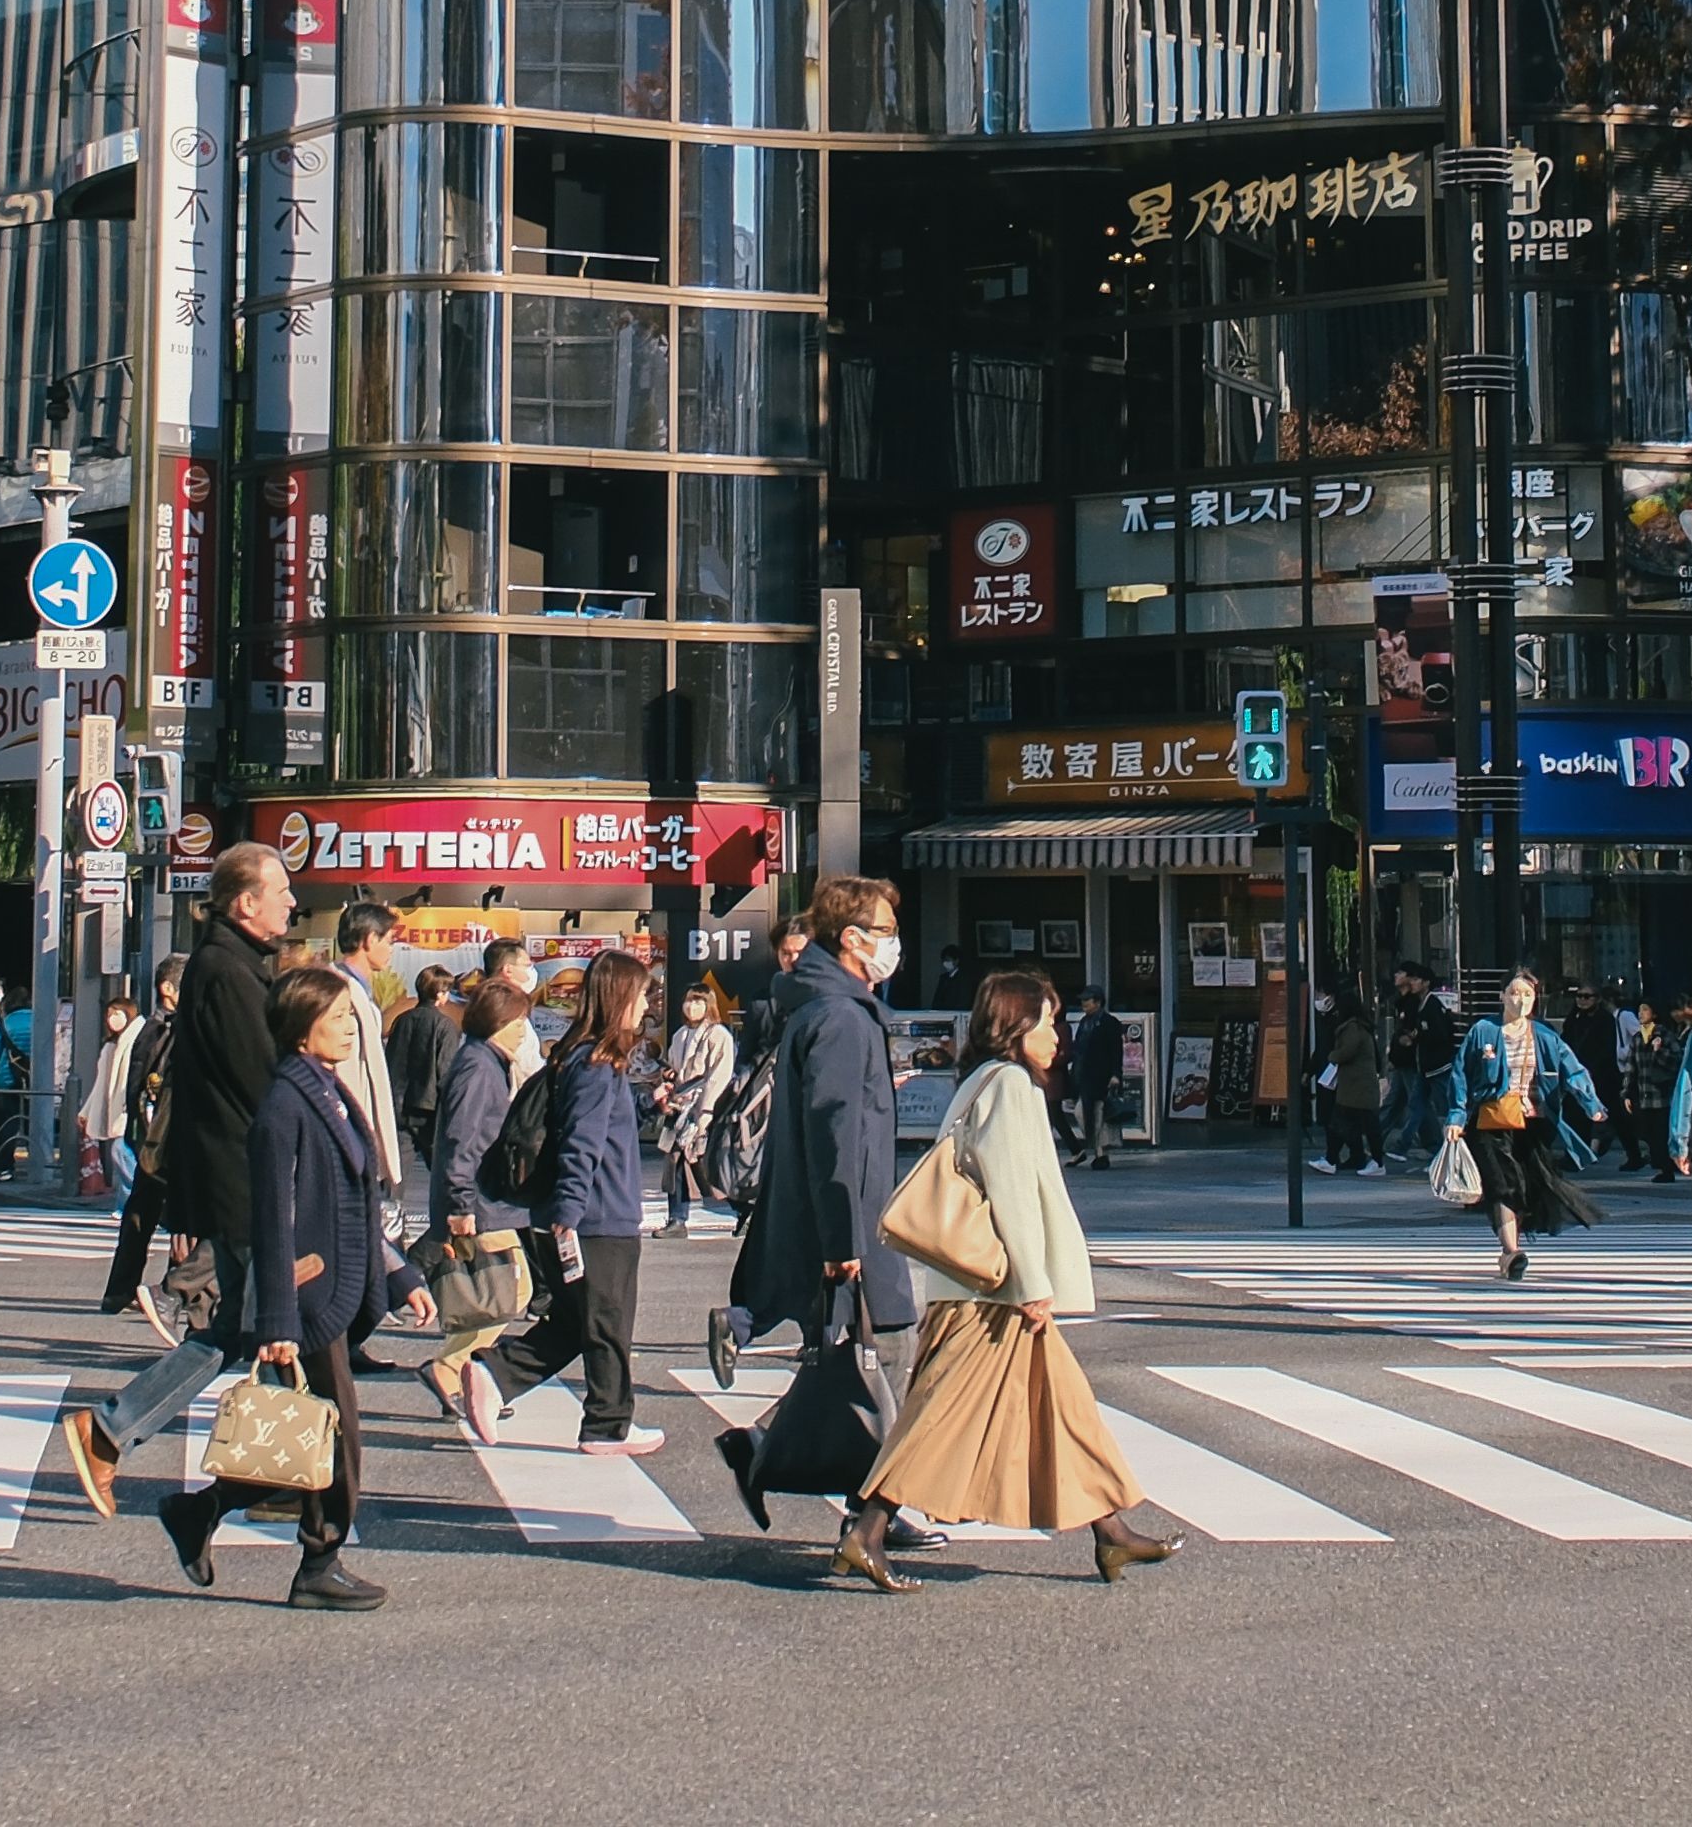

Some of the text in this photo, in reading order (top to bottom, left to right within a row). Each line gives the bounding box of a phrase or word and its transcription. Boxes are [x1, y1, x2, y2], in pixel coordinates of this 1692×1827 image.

[1128, 150, 1430, 248] 星乃珈琲店
[1529, 217, 1594, 240] DRIP
[174, 184, 210, 328] 不二家
[1121, 482, 1376, 534] 不二家レストラン
[179, 508, 205, 670] ZETTERIA
[973, 572, 1032, 599] 不二家
[828, 597, 838, 630] GINZA
[960, 600, 1043, 628] レストラン
[827, 632, 841, 690] CRYSTAL
[163, 679, 202, 707] B1F
[1538, 751, 1619, 776] baskin
[1108, 784, 1170, 798] GINZA
[1393, 776, 1450, 798] Cartier
[465, 817, 523, 831] ゼッテリア
[574, 812, 702, 844] 絶品バーガー
[313, 822, 546, 870] ZETTERIA
[172, 875, 201, 891] B1F
[391, 924, 495, 944] ZETTERIA
[688, 929, 751, 961] B1F
